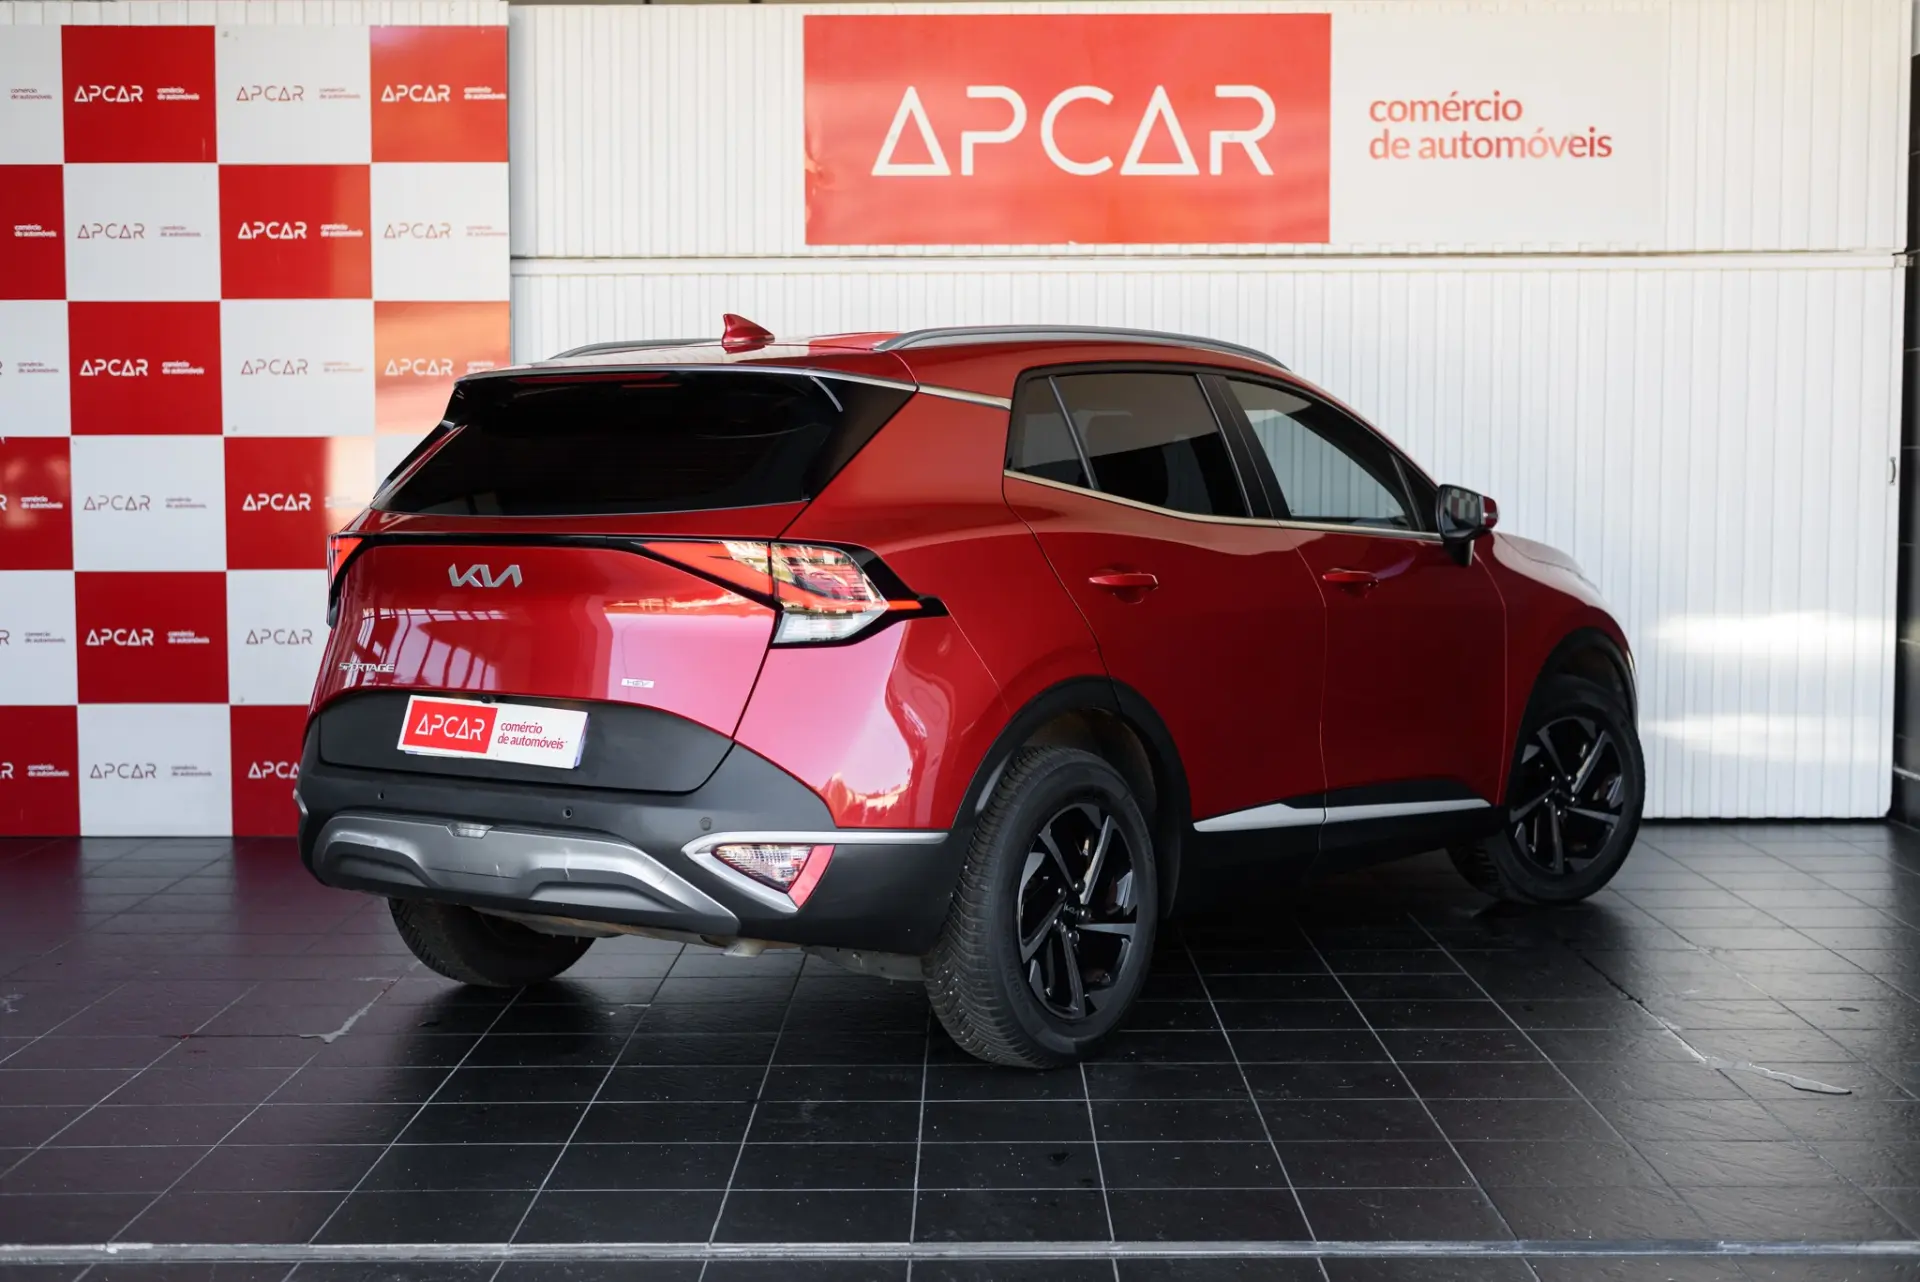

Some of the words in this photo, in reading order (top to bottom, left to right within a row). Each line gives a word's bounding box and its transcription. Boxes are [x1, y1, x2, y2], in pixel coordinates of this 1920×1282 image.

[74, 85, 143, 102] APCAR
[236, 85, 304, 102] APCAR
[381, 84, 450, 103] APCAR
[1369, 90, 1523, 122] comércio
[871, 85, 1277, 177] APCAR
[1369, 128, 1411, 159] de
[1418, 126, 1613, 159] automóveis
[77, 223, 145, 239] APCAR
[238, 221, 307, 239] APCAR
[383, 222, 451, 239] APCAR
[80, 359, 148, 376] APCAR
[241, 359, 308, 375] APCAR
[385, 359, 453, 376] APCAR
[83, 495, 150, 511] APCAR
[242, 493, 311, 511] APCAR
[86, 628, 154, 646] APCAR
[246, 629, 312, 645] APCAR
[339, 662, 395, 673] SPORTAGE
[415, 713, 486, 741] APCAR
[500, 721, 543, 734] comércio
[497, 733, 510, 745] de
[512, 735, 564, 750] automóveis
[90, 763, 157, 779] APCAR
